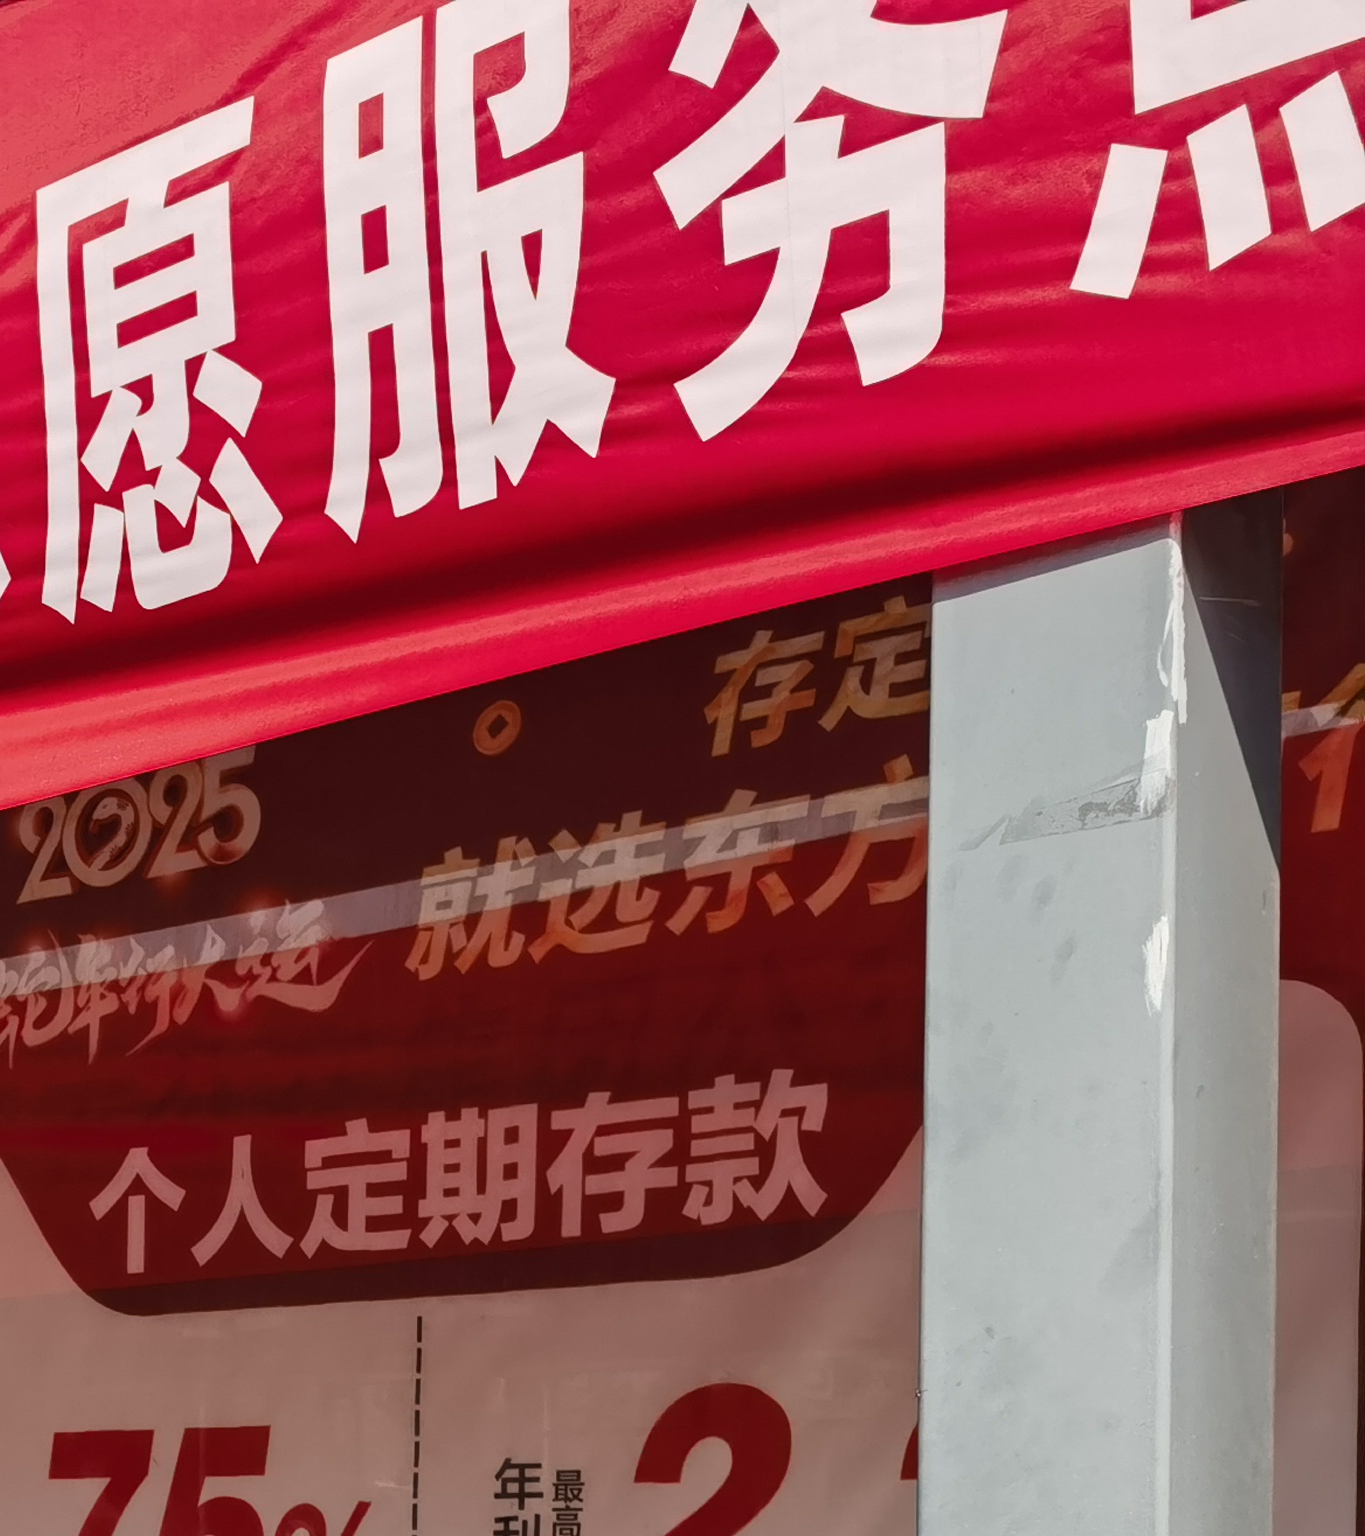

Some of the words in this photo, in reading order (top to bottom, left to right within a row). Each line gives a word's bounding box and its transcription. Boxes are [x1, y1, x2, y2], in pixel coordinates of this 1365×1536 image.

[16, 746, 261, 905] 2025
[88, 1067, 829, 1274] 个人定期存款
